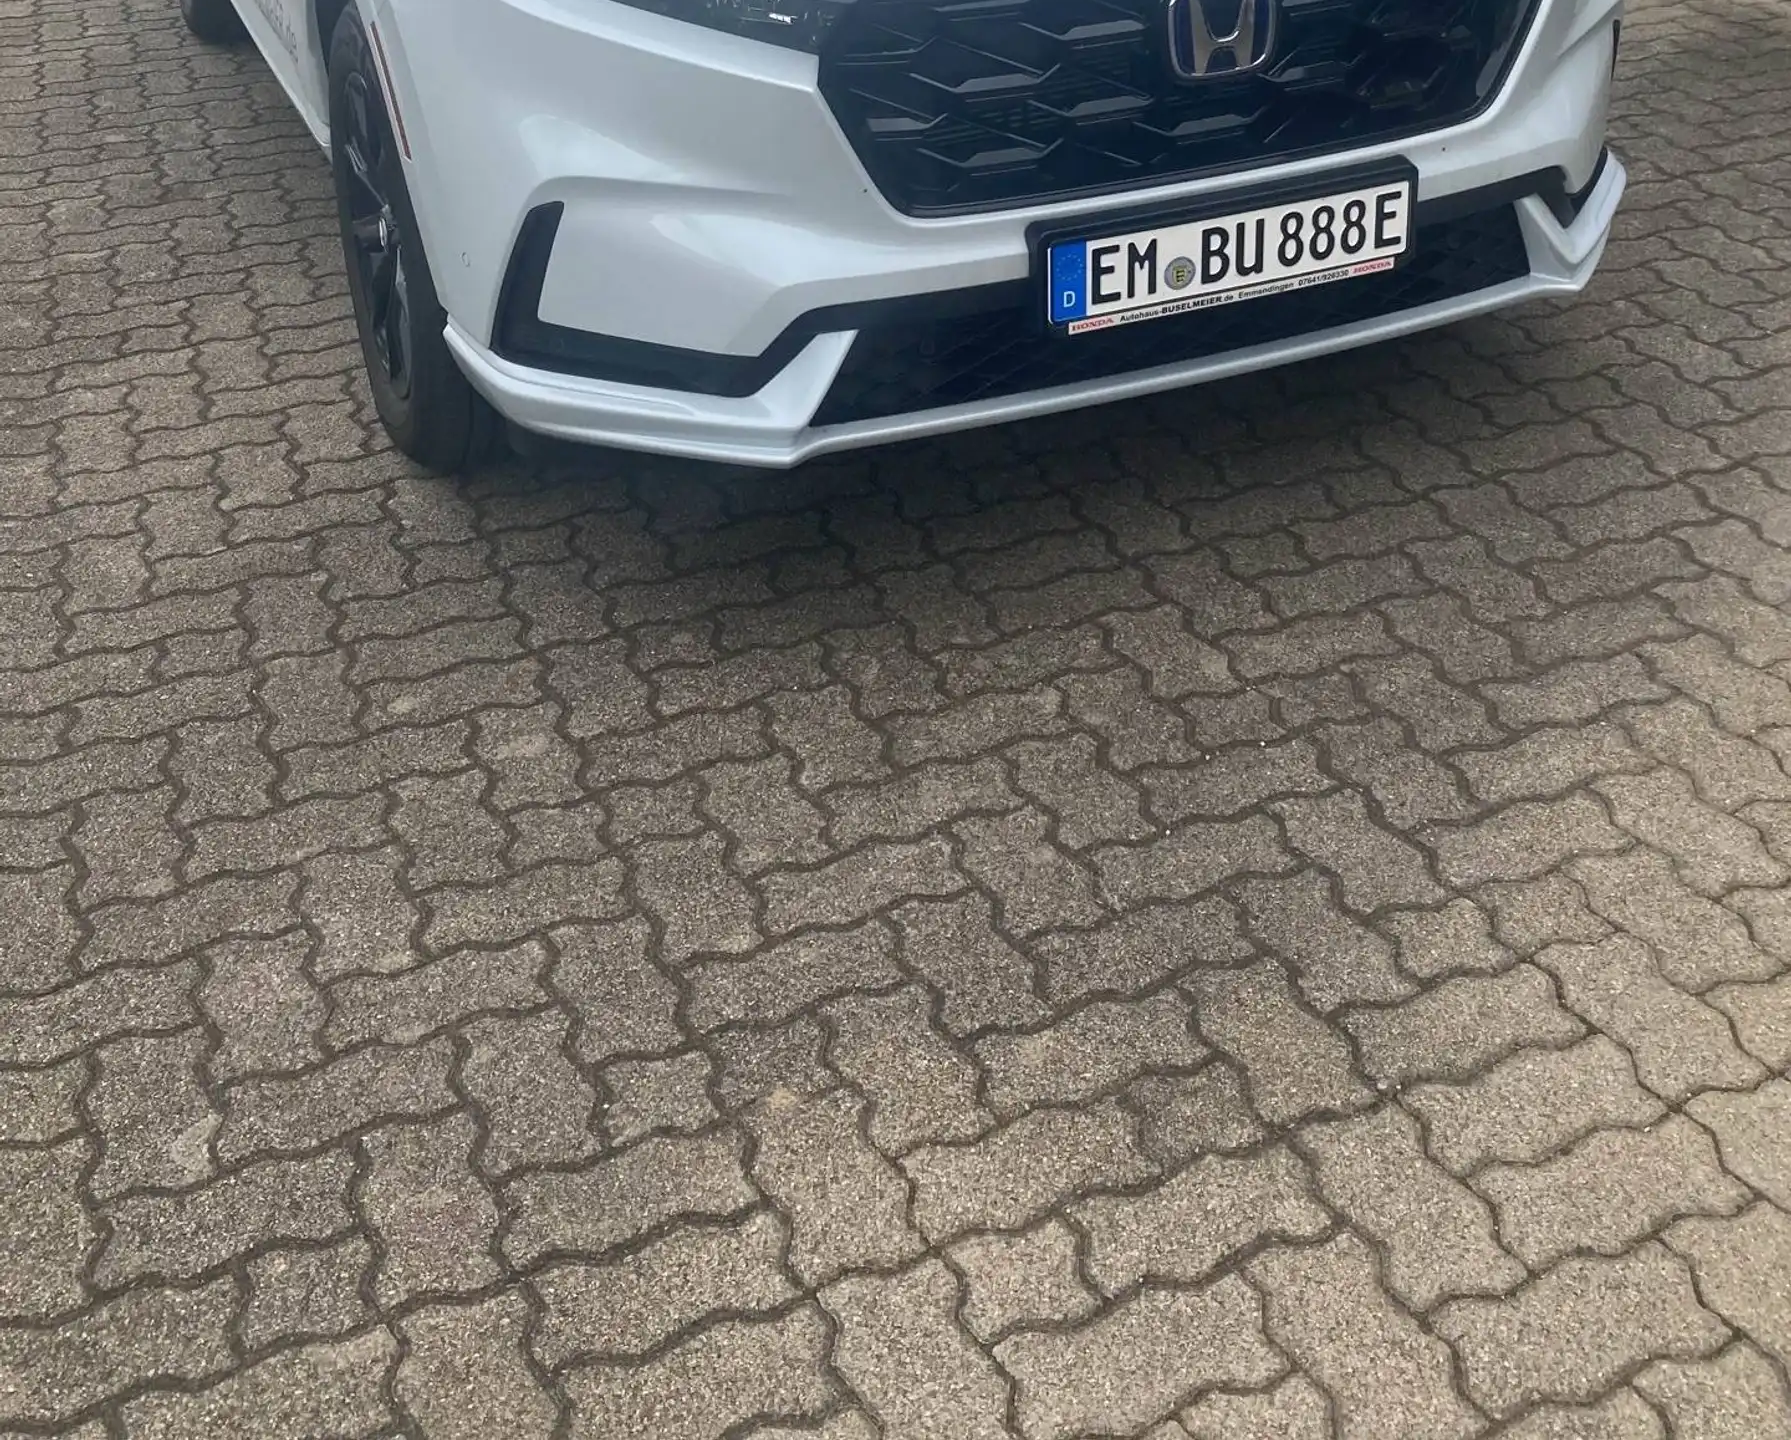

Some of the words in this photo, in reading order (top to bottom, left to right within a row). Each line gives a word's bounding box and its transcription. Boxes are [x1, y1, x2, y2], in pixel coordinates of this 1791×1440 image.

[1091, 238, 1158, 305] EM
[1200, 218, 1265, 287] BU
[1277, 190, 1402, 267] 888E
[1063, 290, 1076, 308] D
[1071, 317, 1114, 332] HONDA
